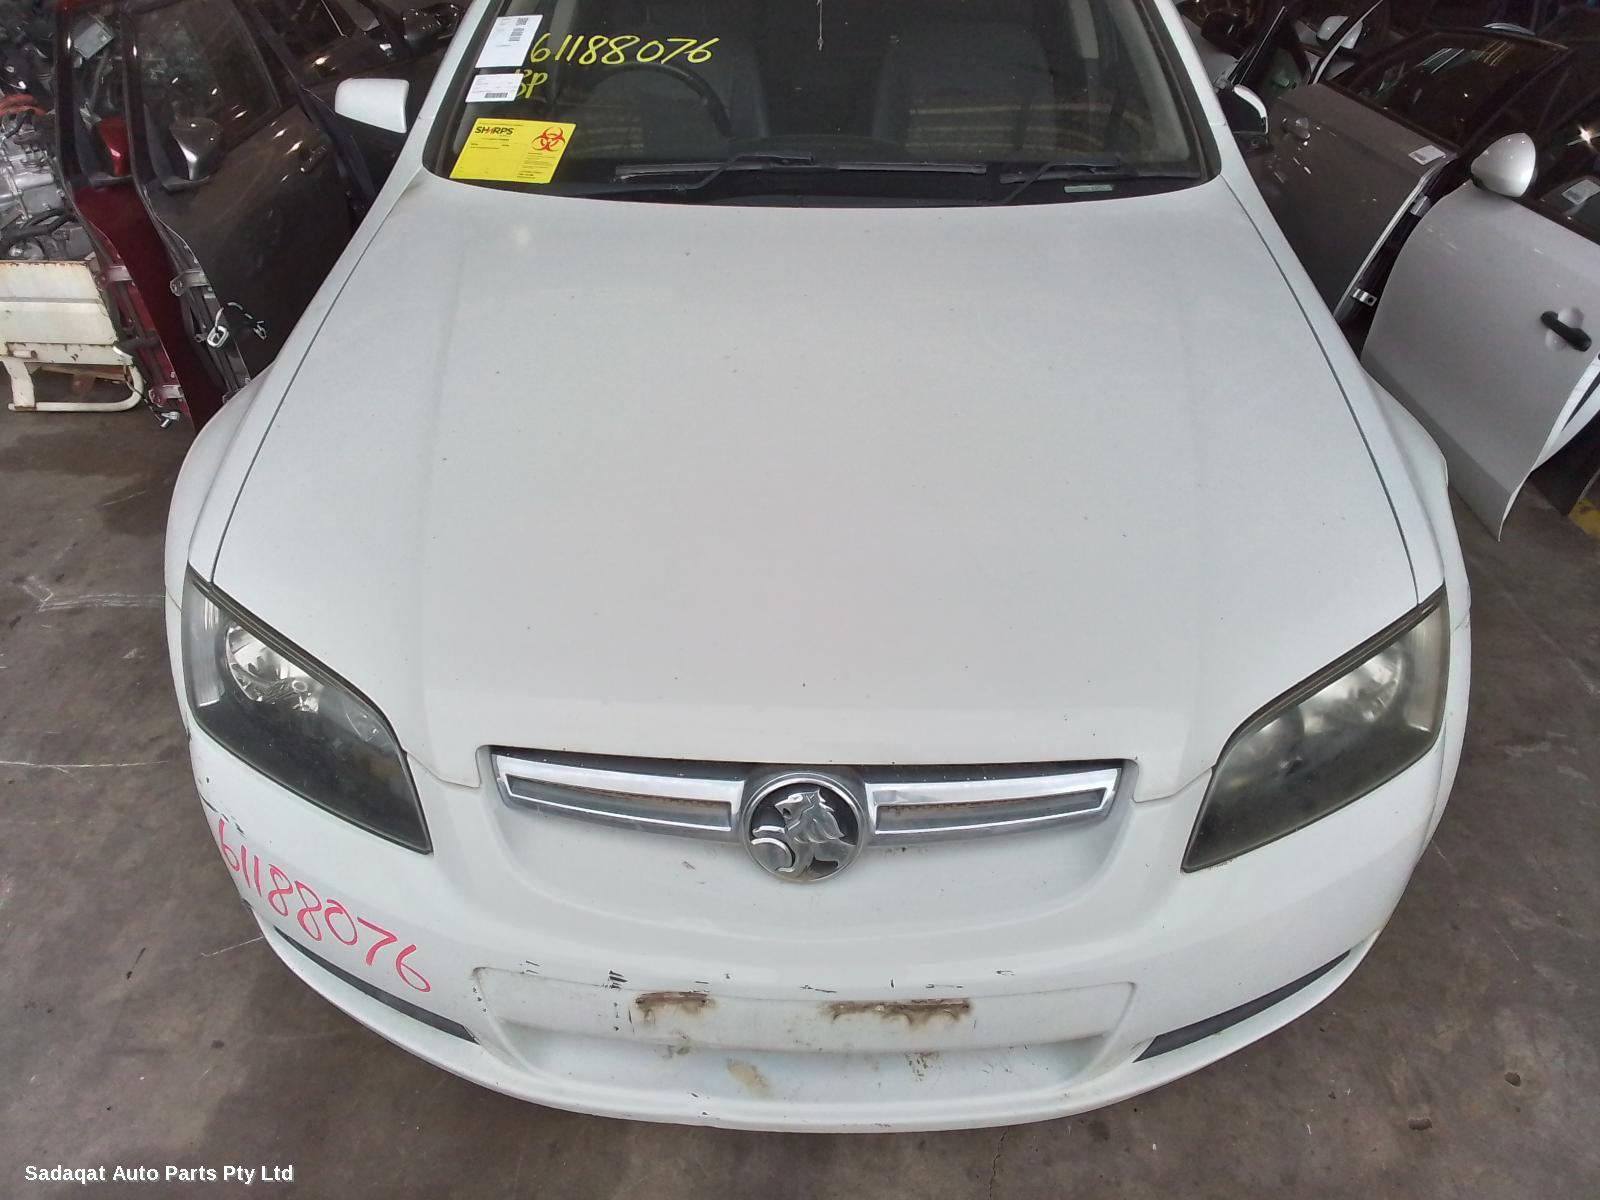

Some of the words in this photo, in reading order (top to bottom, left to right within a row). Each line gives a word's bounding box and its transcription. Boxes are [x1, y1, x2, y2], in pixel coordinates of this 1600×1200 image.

[530, 32, 720, 65] 61188076
[475, 126, 515, 136] SHARPS
[218, 818, 431, 993] 61188076
